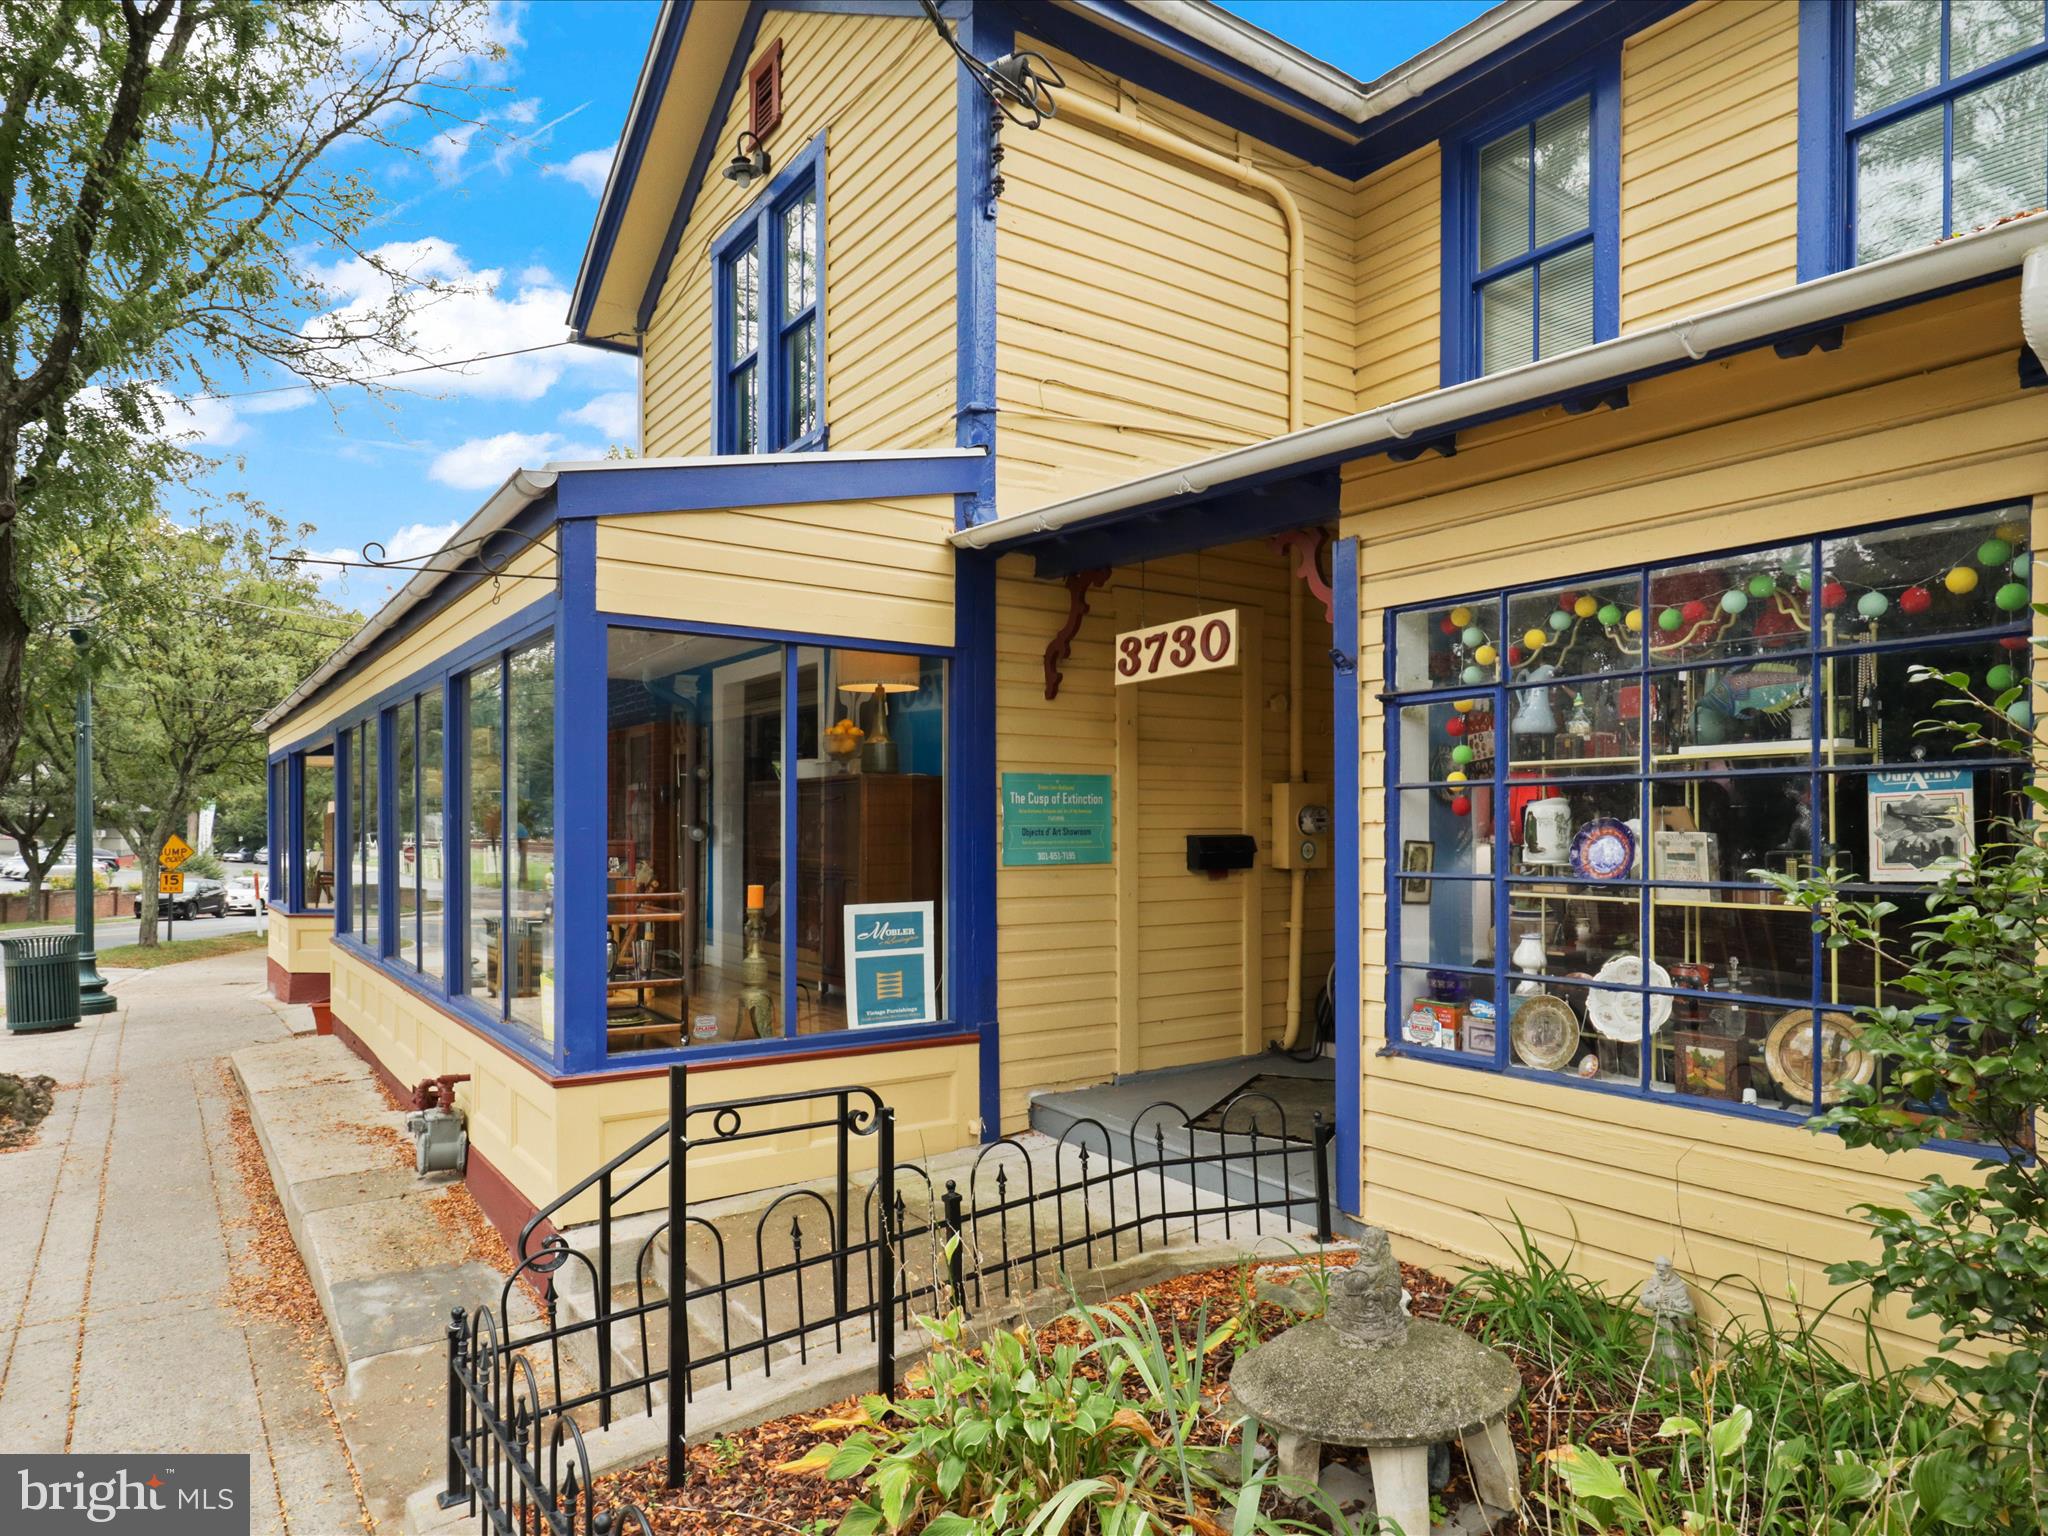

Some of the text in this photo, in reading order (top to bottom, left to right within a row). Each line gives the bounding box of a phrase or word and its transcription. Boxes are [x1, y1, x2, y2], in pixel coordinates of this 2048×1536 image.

[1118, 619, 1231, 677] 3730
[1876, 771, 1911, 783] Our
[1010, 792, 1103, 807] The Cusp of Extinction
[1022, 827, 1044, 839] Objects
[1052, 828, 1063, 836] Art
[1063, 828, 1092, 836] Showroom
[160, 848, 188, 856] UMP
[164, 875, 179, 885] 15
